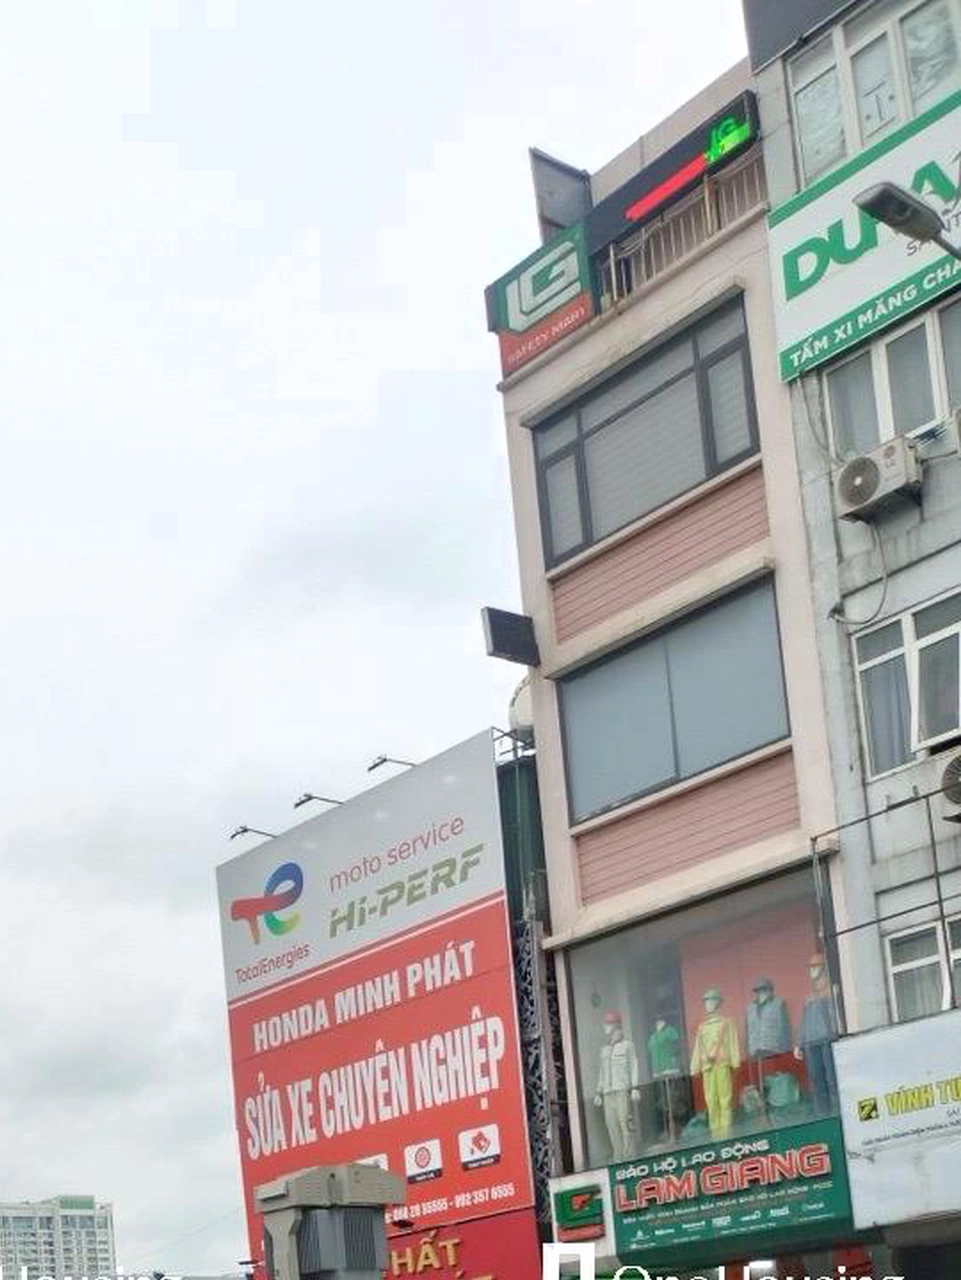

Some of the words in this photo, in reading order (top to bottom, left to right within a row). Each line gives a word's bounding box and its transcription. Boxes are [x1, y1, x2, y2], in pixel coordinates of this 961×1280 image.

[789, 336, 829, 369] TẤM
[834, 322, 853, 345] XI
[857, 290, 918, 330] MĂNG
[329, 852, 381, 894] moto
[387, 815, 465, 869] service
[236, 941, 311, 983] TotalEnergies
[253, 998, 329, 1053] HONDA
[334, 971, 400, 1024] MINH
[406, 932, 476, 998] PHÁT
[244, 1072, 285, 1160] SỬA
[290, 1080, 319, 1149] XE
[319, 1042, 409, 1140] CHUYÊN
[411, 1003, 505, 1113] NGHIỆP
[615, 1169, 696, 1212] LAM
[700, 1143, 831, 1195] GIANG
[720, 1139, 770, 1160] ĐỘNG
